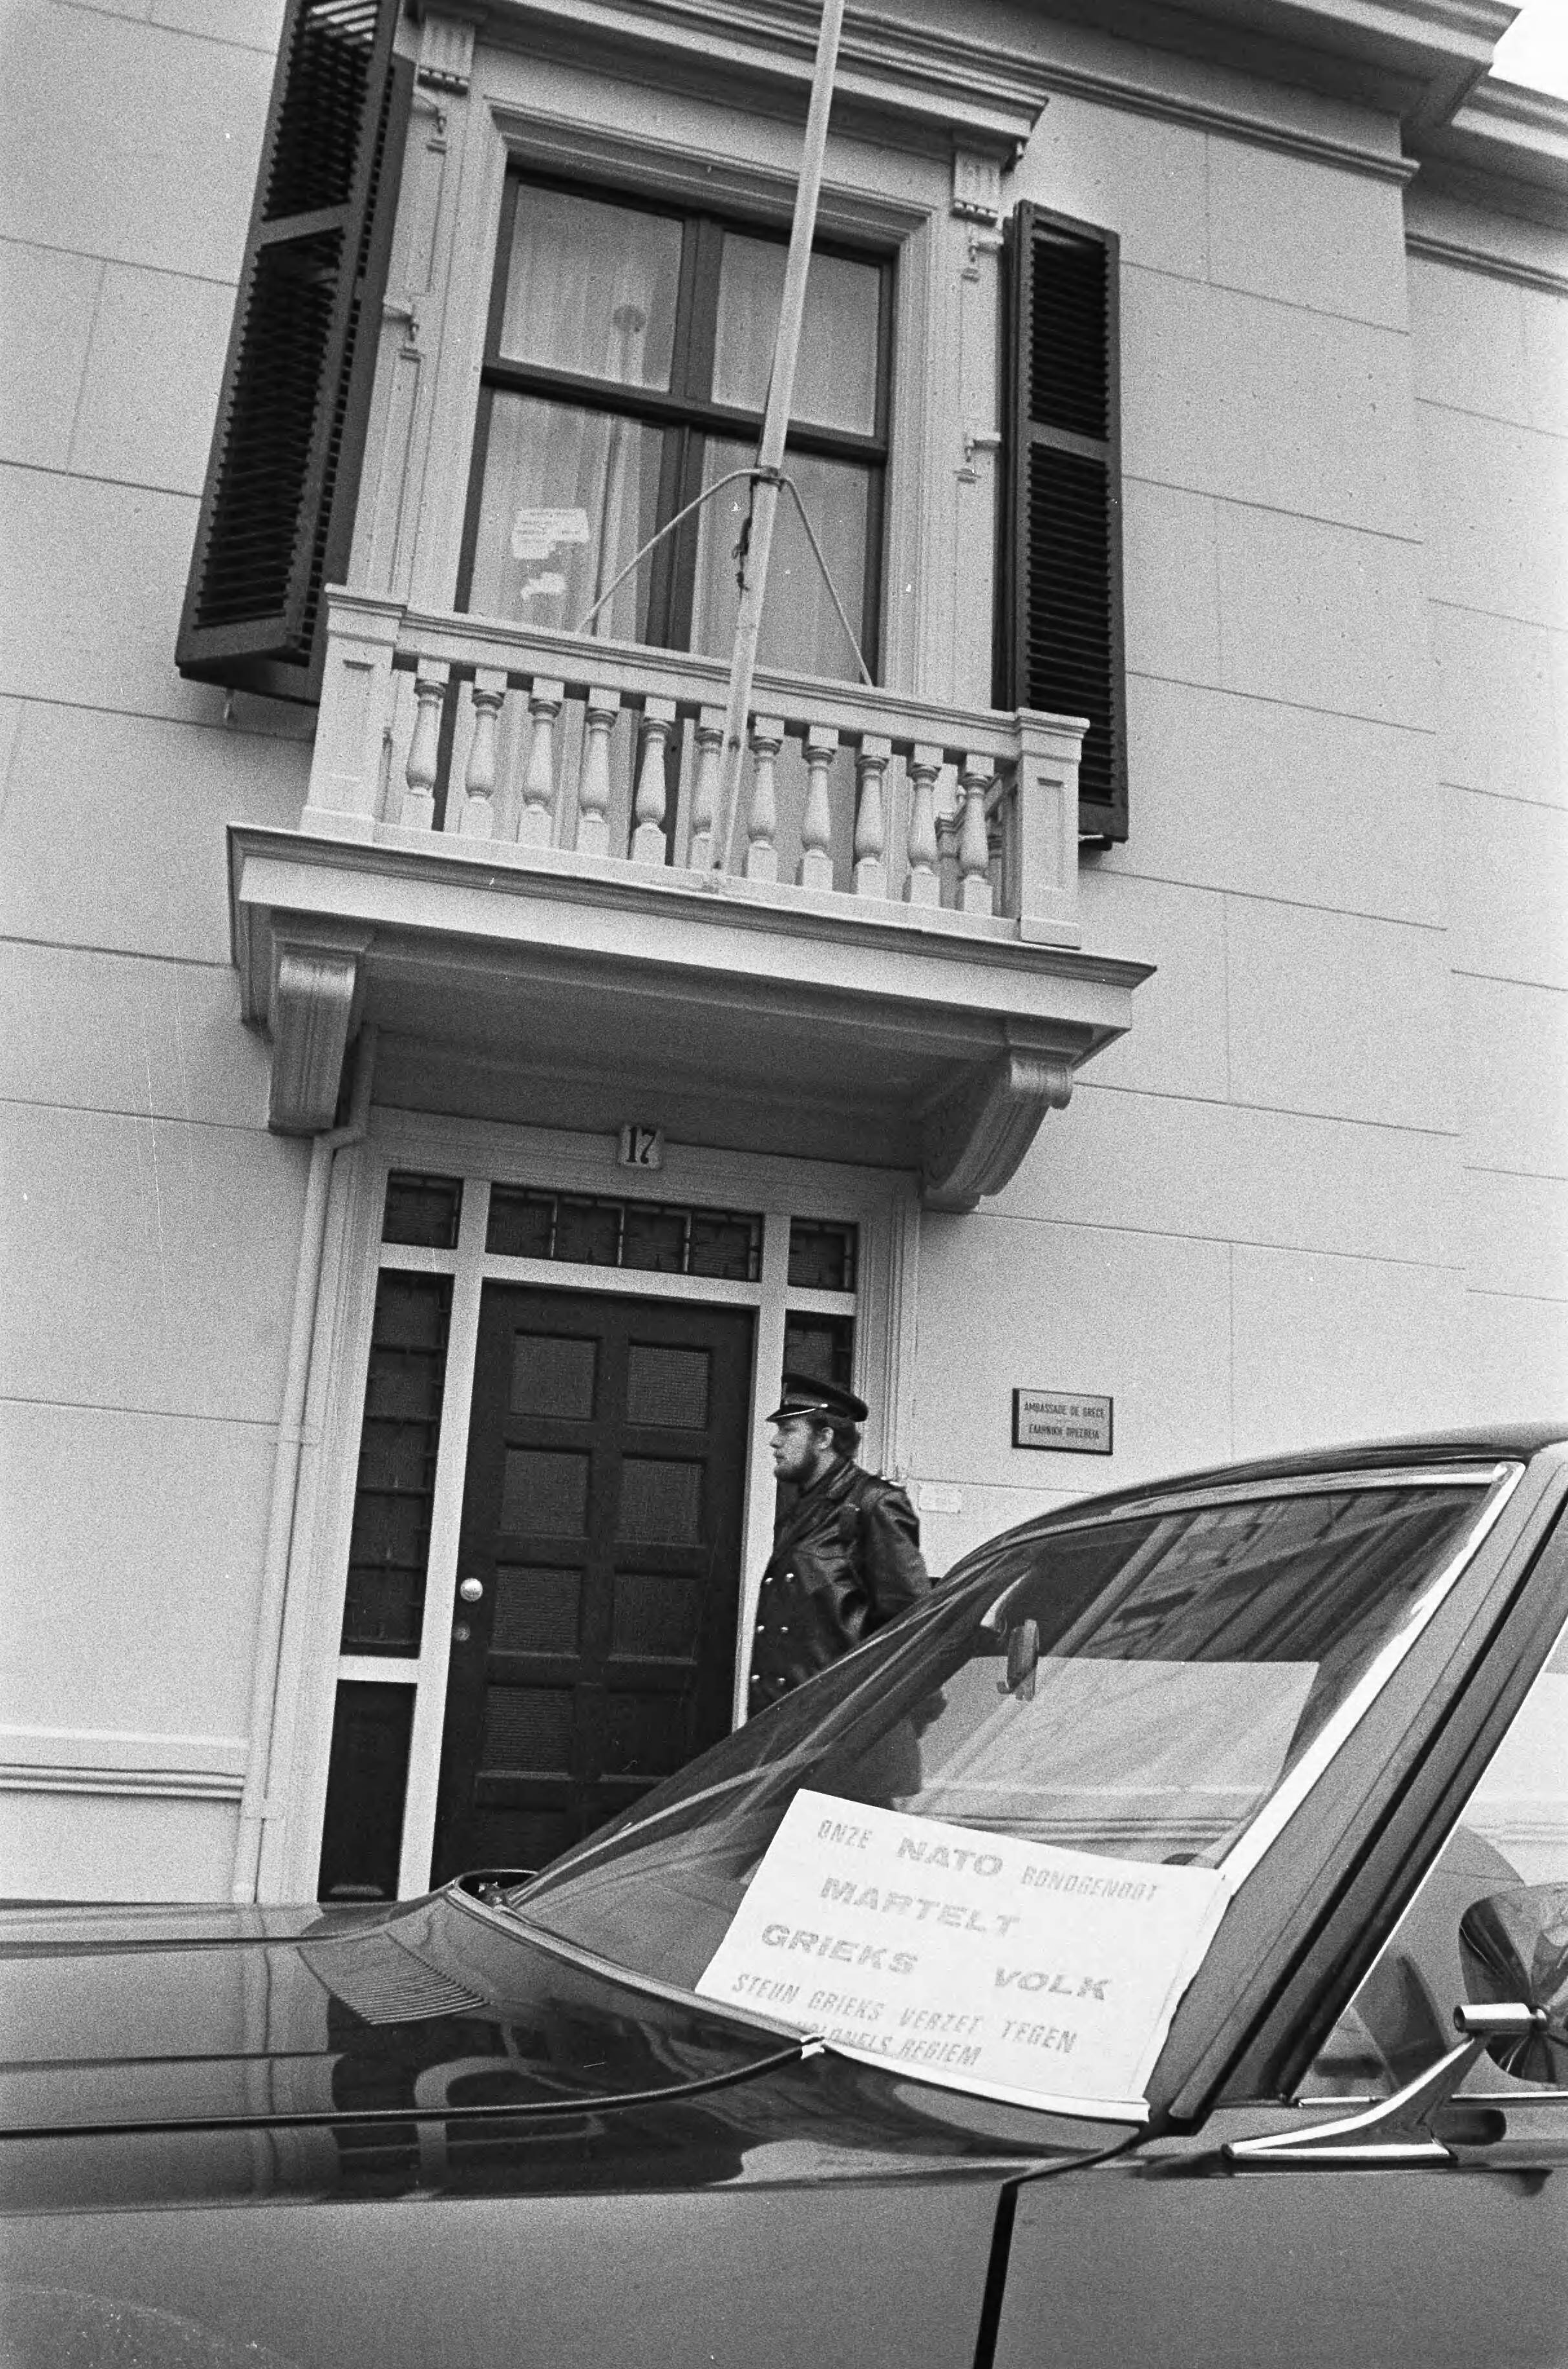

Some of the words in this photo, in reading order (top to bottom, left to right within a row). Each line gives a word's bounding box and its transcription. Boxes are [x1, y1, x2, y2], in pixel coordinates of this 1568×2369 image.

[626, 1127, 657, 1164] 17
[1024, 1401, 1067, 1416] AMBASSADE
[1070, 1405, 1080, 1417] DE
[817, 1820, 873, 1849] ONZE
[896, 1836, 1003, 1876] NATO
[1021, 1865, 1158, 1902] BONDGENOOT
[820, 1877, 1020, 1936] MARTELT
[761, 1923, 918, 1975] GRIEKS
[994, 1966, 1112, 2001] VOLK
[732, 1973, 800, 2004] STEUN
[809, 1990, 885, 2021] GRIEKS
[899, 2006, 983, 2034] VERZET
[1001, 2020, 1077, 2054] TEGEN
[897, 2038, 982, 2065] REGIEM
